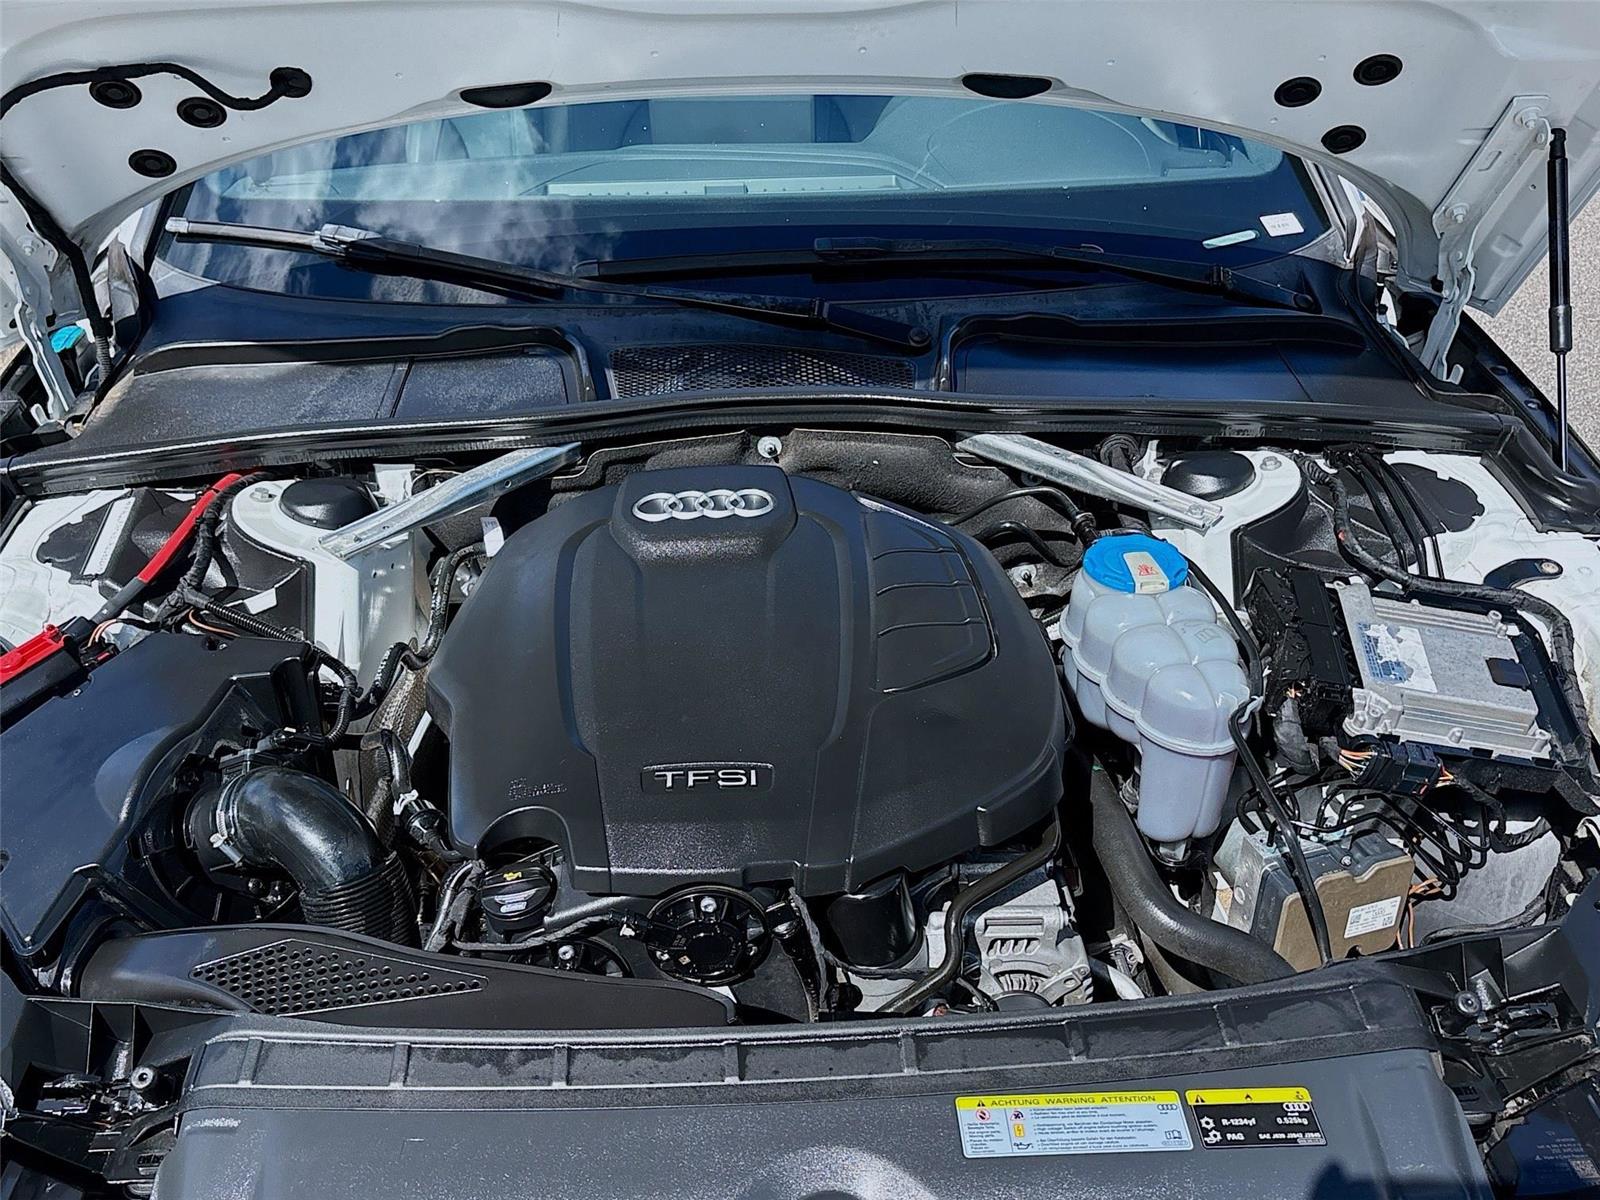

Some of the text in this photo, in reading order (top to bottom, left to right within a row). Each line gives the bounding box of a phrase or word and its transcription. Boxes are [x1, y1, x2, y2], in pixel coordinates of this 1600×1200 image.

[655, 769, 757, 788] TFSI
[990, 1095, 1156, 1107] ACHTUNG WARNING ATTENTION
[1221, 1117, 1257, 1127] R-1234yf
[1226, 1132, 1245, 1141] PAG
